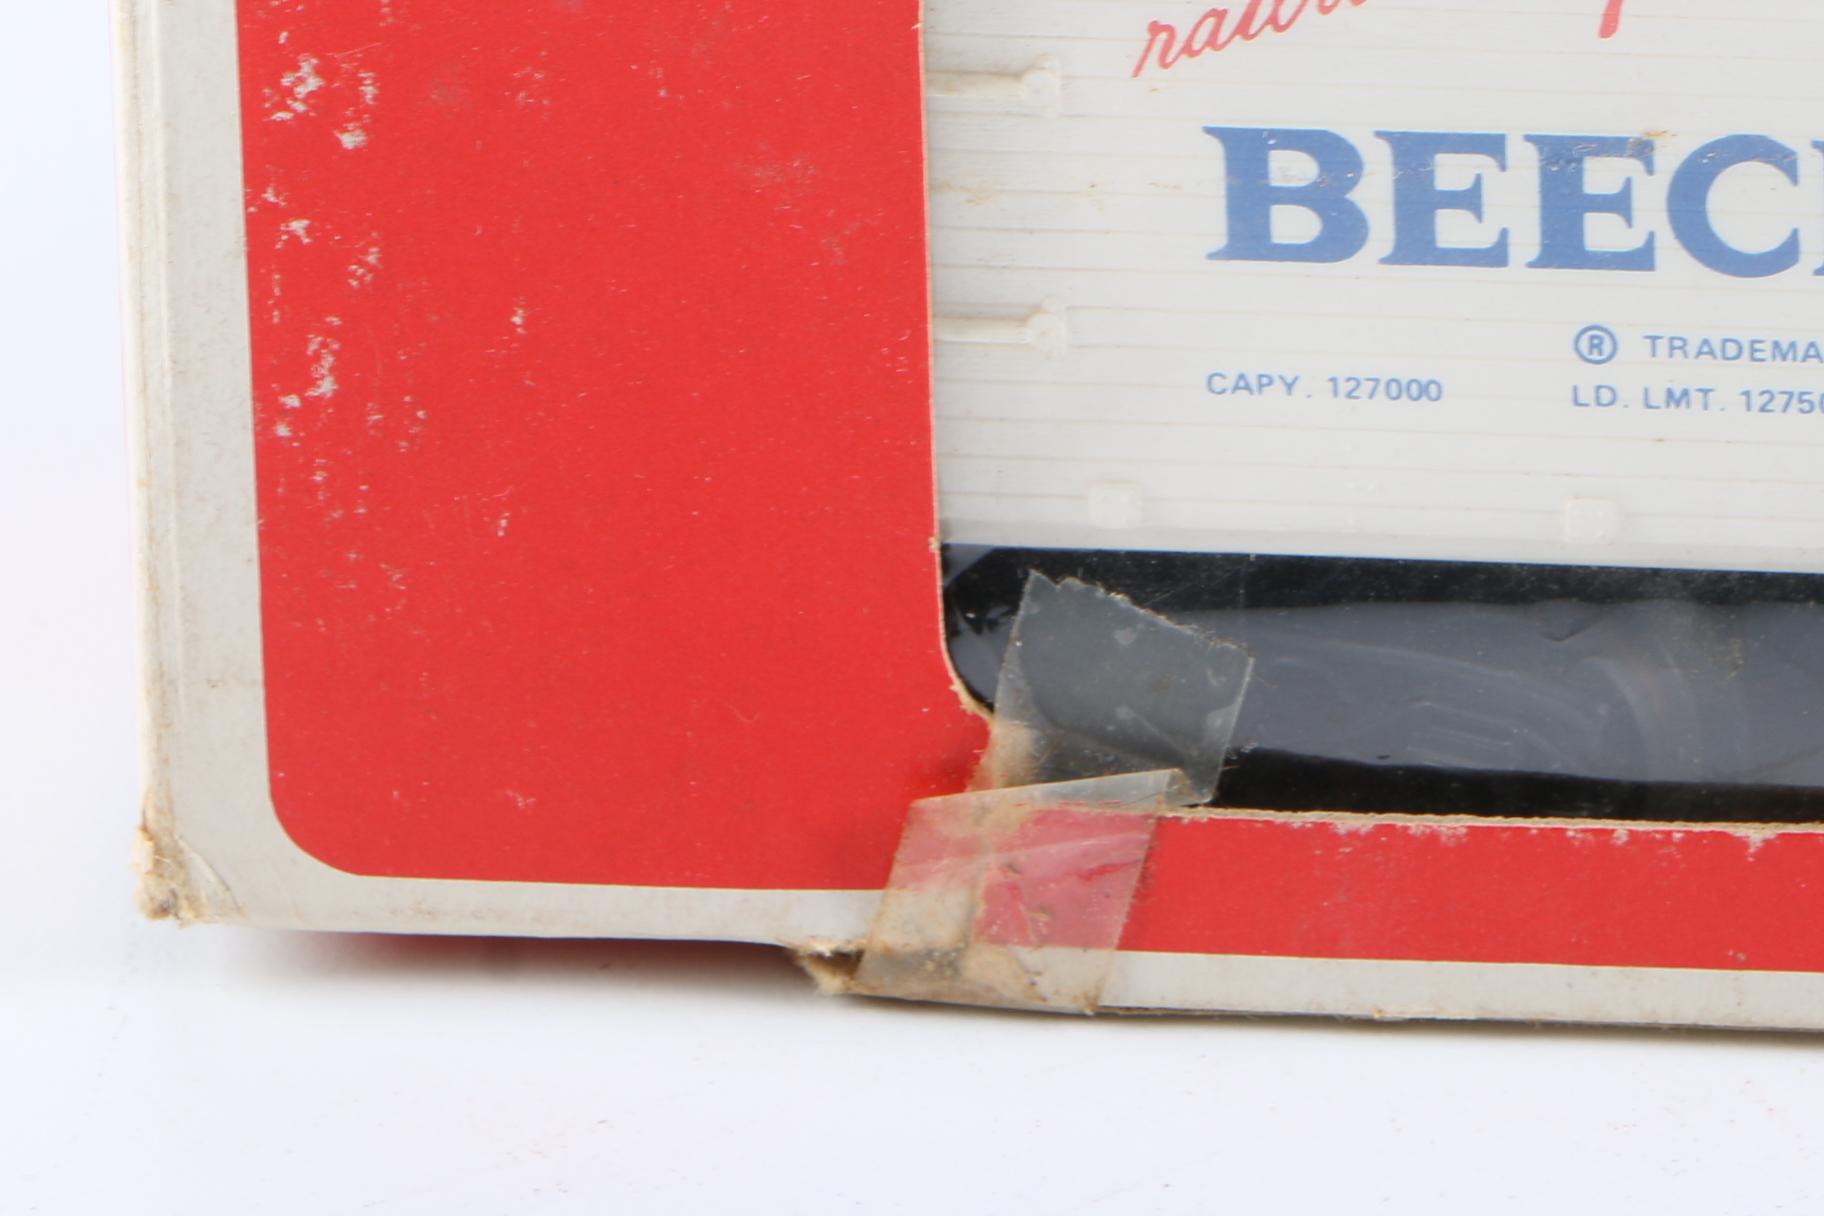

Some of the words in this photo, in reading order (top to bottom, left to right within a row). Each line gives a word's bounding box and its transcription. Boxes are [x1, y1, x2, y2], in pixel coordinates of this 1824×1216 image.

[1205, 371, 1314, 399] CAPY.
[1326, 375, 1445, 402] 127000
[1571, 384, 1631, 408] LD.
[1642, 386, 1727, 412] LMT.
